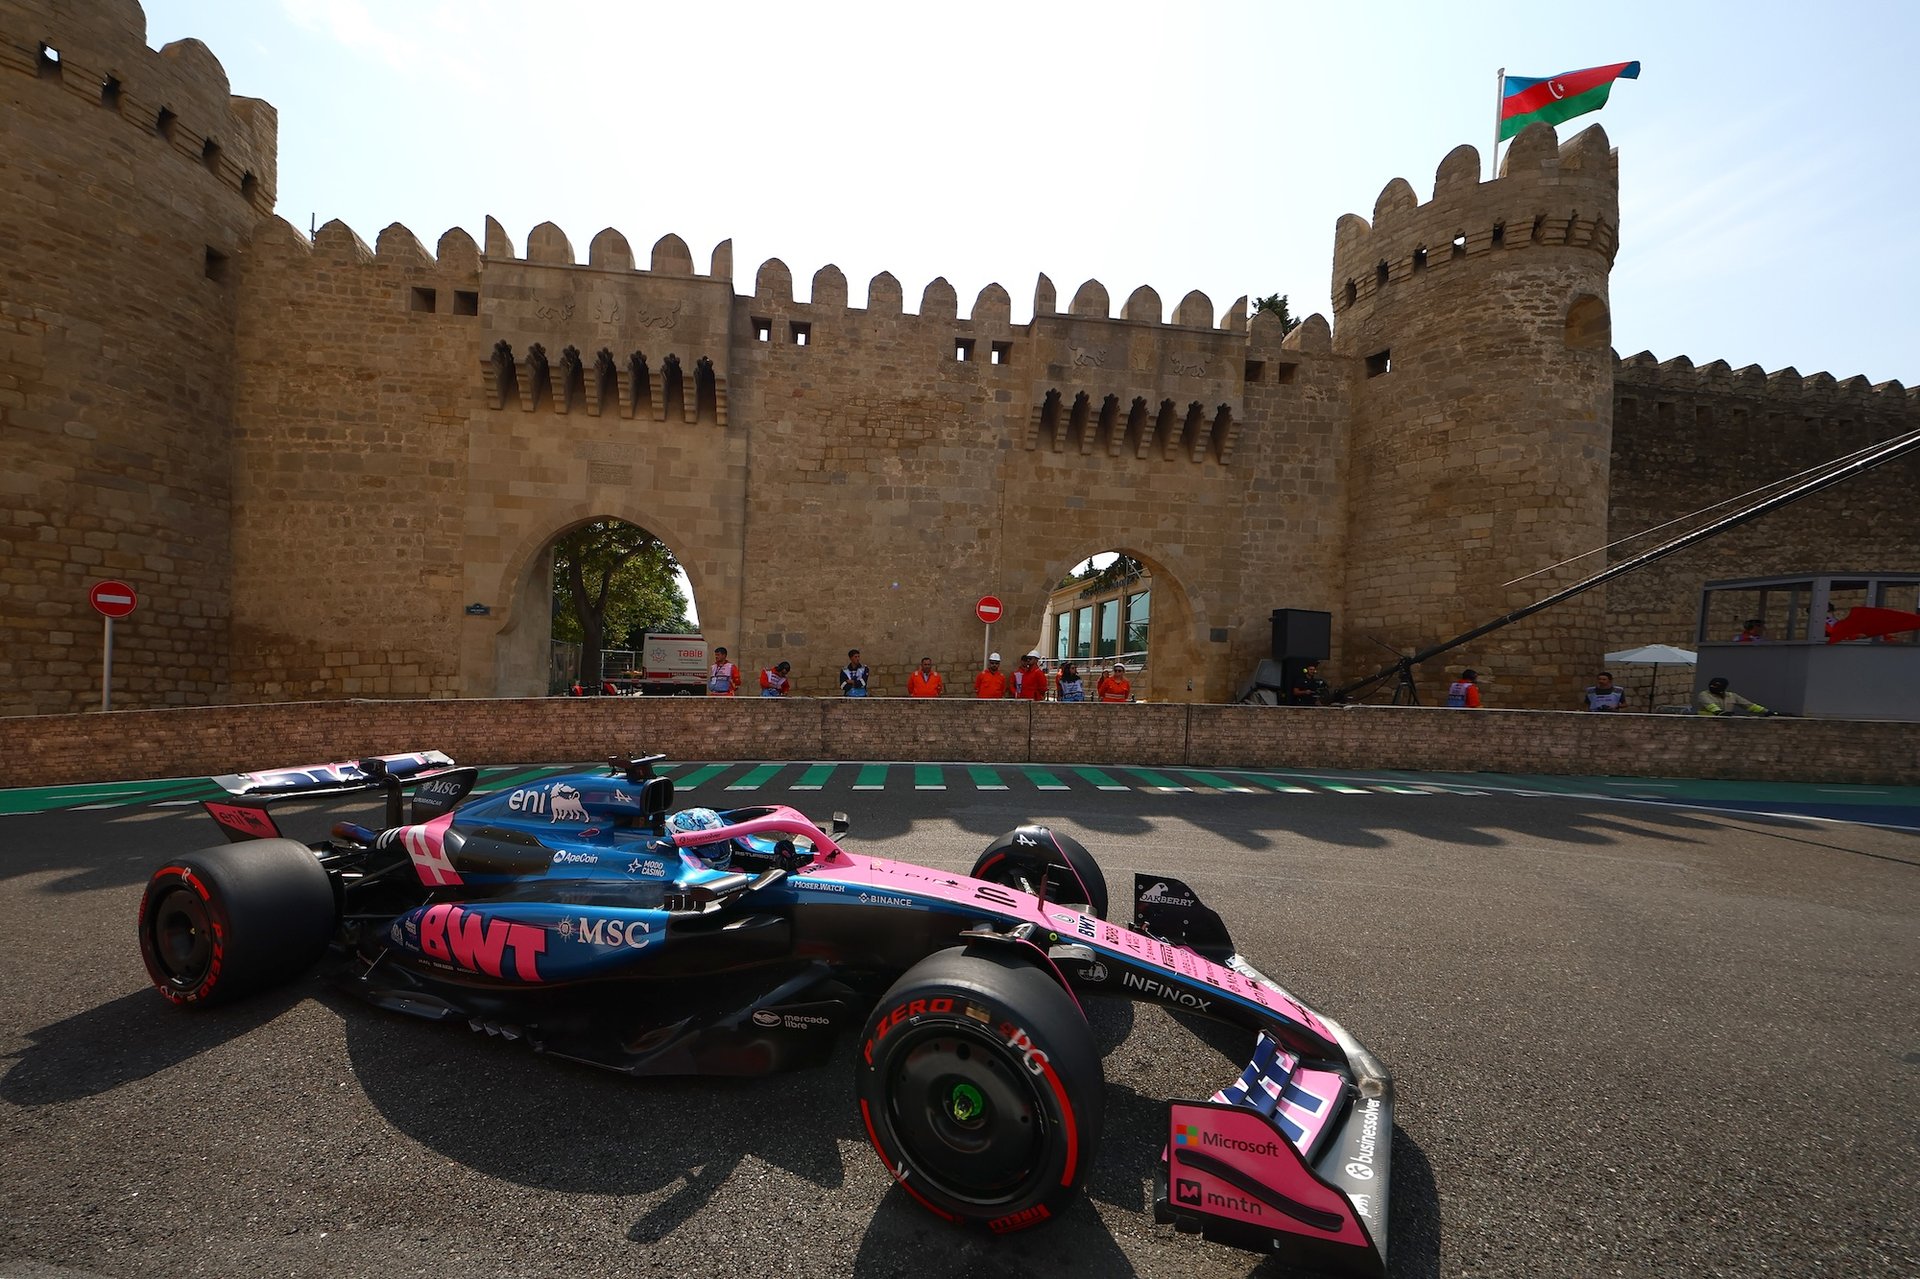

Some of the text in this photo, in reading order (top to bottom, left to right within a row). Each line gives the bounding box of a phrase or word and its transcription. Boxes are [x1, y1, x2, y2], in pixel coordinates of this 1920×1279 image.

[431, 780, 461, 796] MSC
[509, 785, 549, 815] eni
[219, 810, 246, 826] eni
[564, 853, 598, 864] ApeCoin
[643, 860, 664, 869] MODO
[641, 867, 665, 877] CASINO
[871, 896, 912, 907] BINANCE
[974, 886, 1018, 909] 10
[1139, 893, 1195, 907] OAKBERRY
[577, 917, 650, 949] MSC
[1078, 915, 1096, 938] BWT
[420, 904, 545, 982] BWT
[1122, 971, 1212, 1013] INFINOX
[784, 1015, 830, 1025] mercado
[785, 1021, 808, 1030] libre
[876, 998, 954, 1041] ZERO
[1359, 1098, 1381, 1164] businessolver
[1203, 1131, 1279, 1158] Microsoft
[1207, 1192, 1262, 1216] mntn
